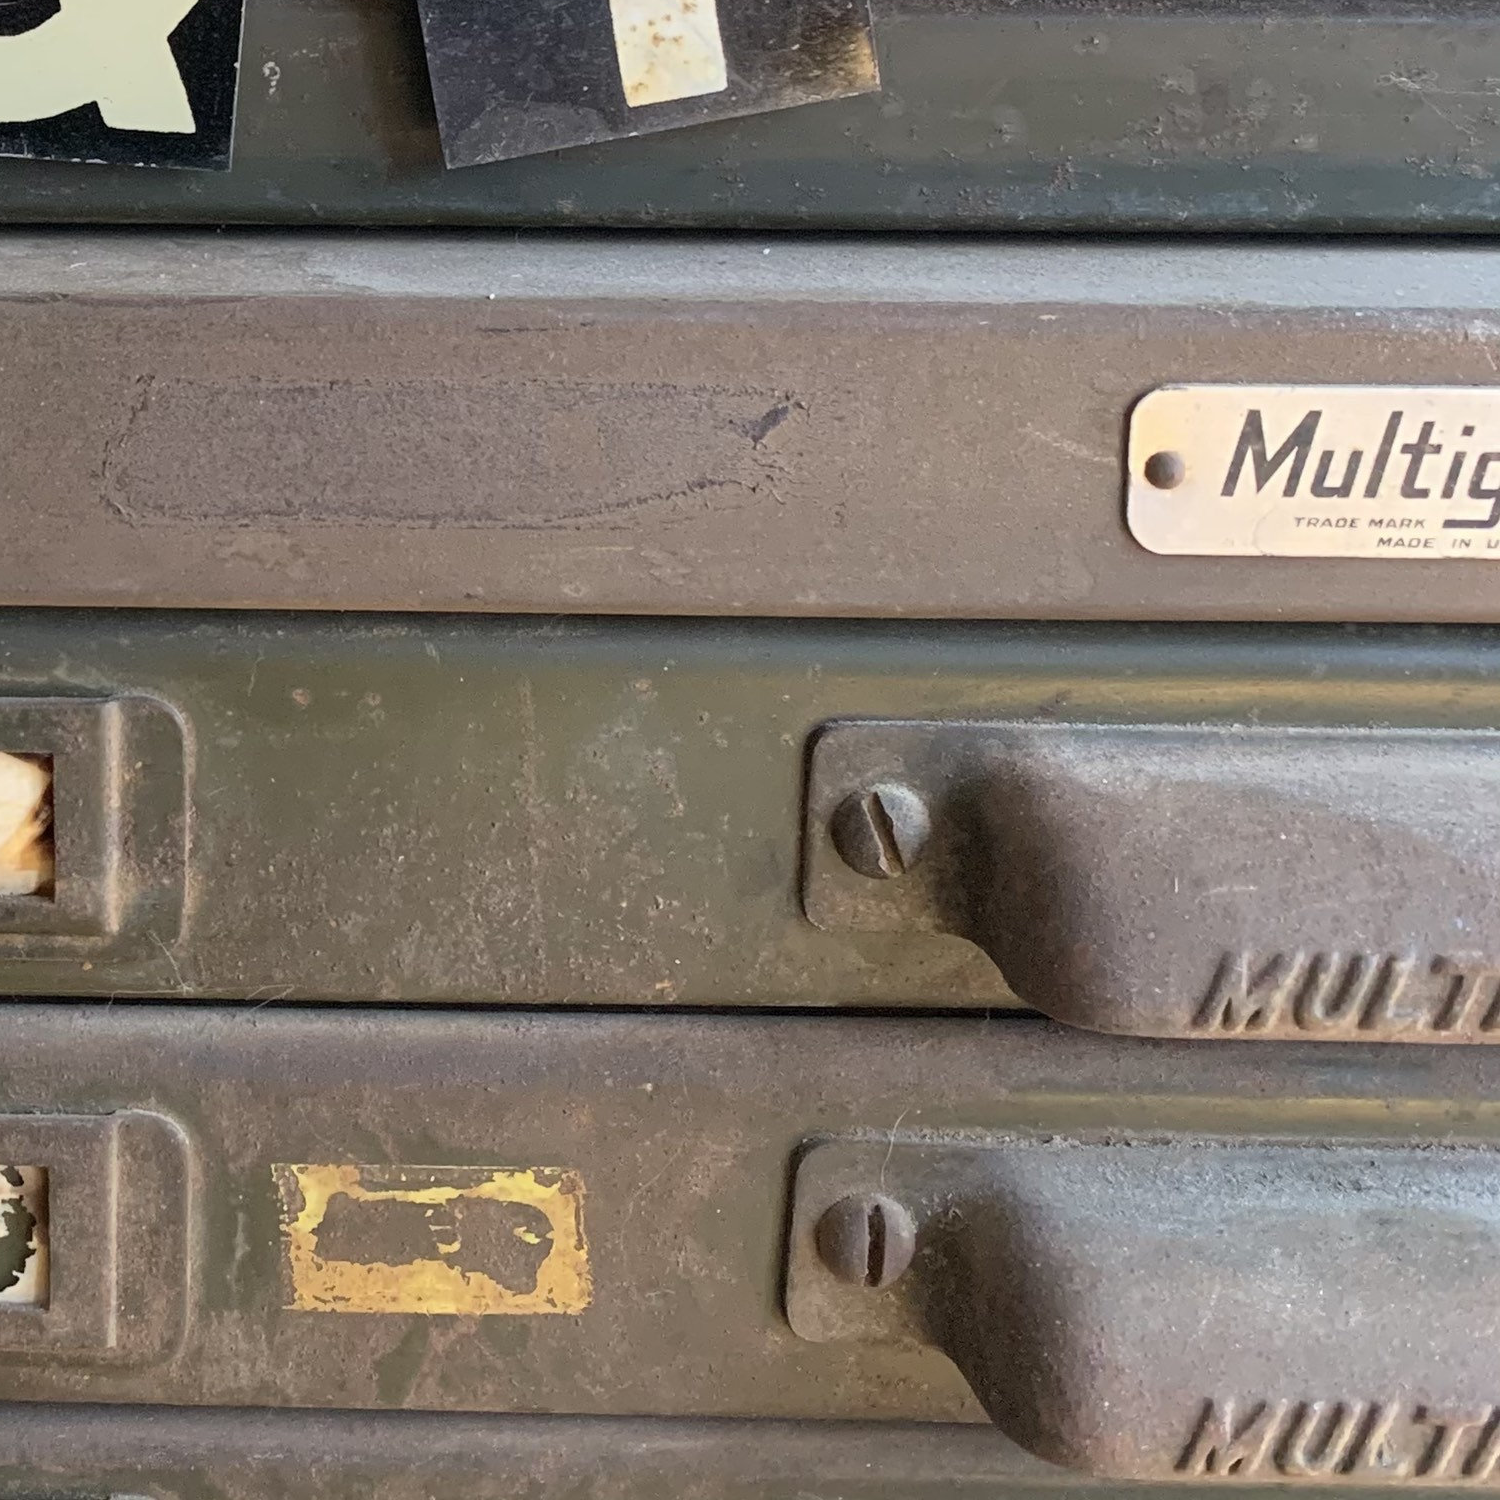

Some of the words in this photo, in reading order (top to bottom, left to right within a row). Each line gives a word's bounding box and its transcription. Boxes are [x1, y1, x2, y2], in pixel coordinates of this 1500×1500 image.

[1293, 516, 1361, 529] TRADE
[1368, 518, 1427, 529] MARK
[1376, 537, 1437, 549] MADE
[1451, 538, 1472, 549] IN
